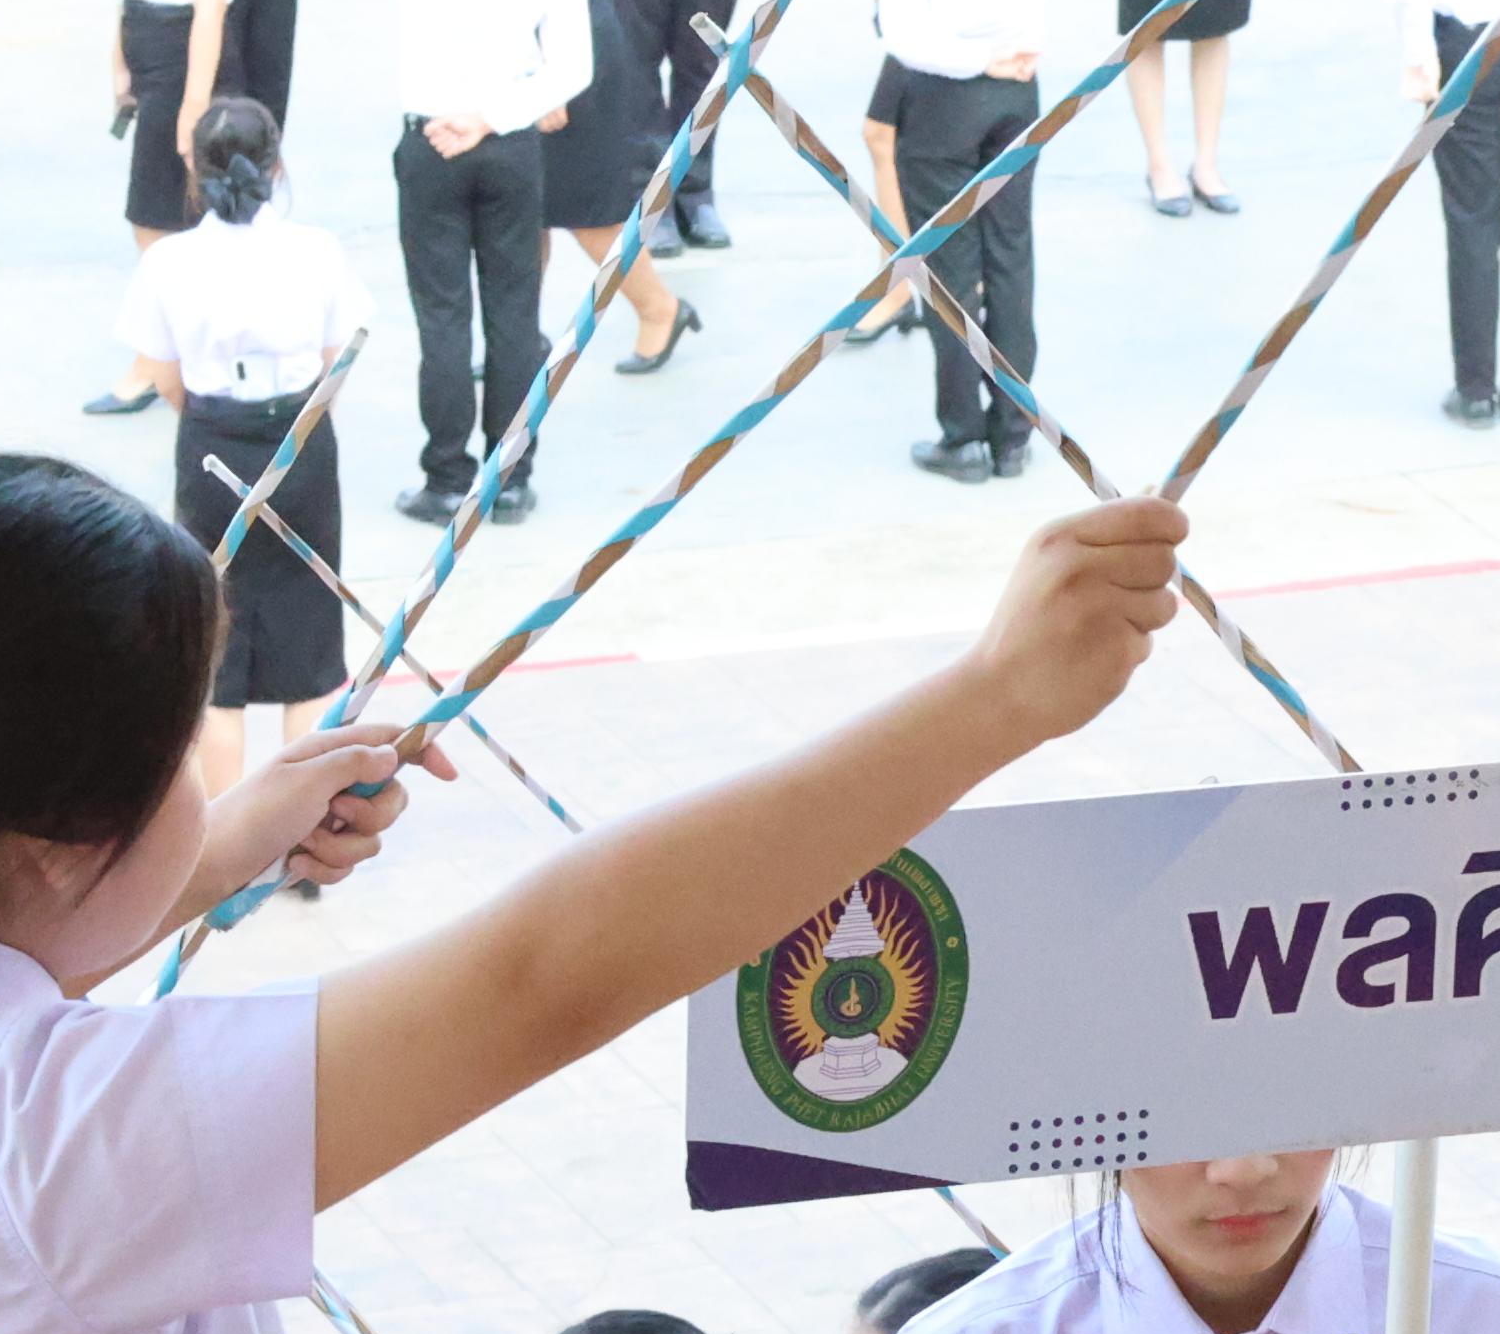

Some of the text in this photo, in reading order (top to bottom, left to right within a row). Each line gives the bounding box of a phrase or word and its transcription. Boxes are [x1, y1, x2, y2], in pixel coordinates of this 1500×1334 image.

[743, 991, 788, 1096] KAMPHAENG
[784, 1094, 827, 1124] PHET
[915, 977, 960, 1080] UNIVERSITY
